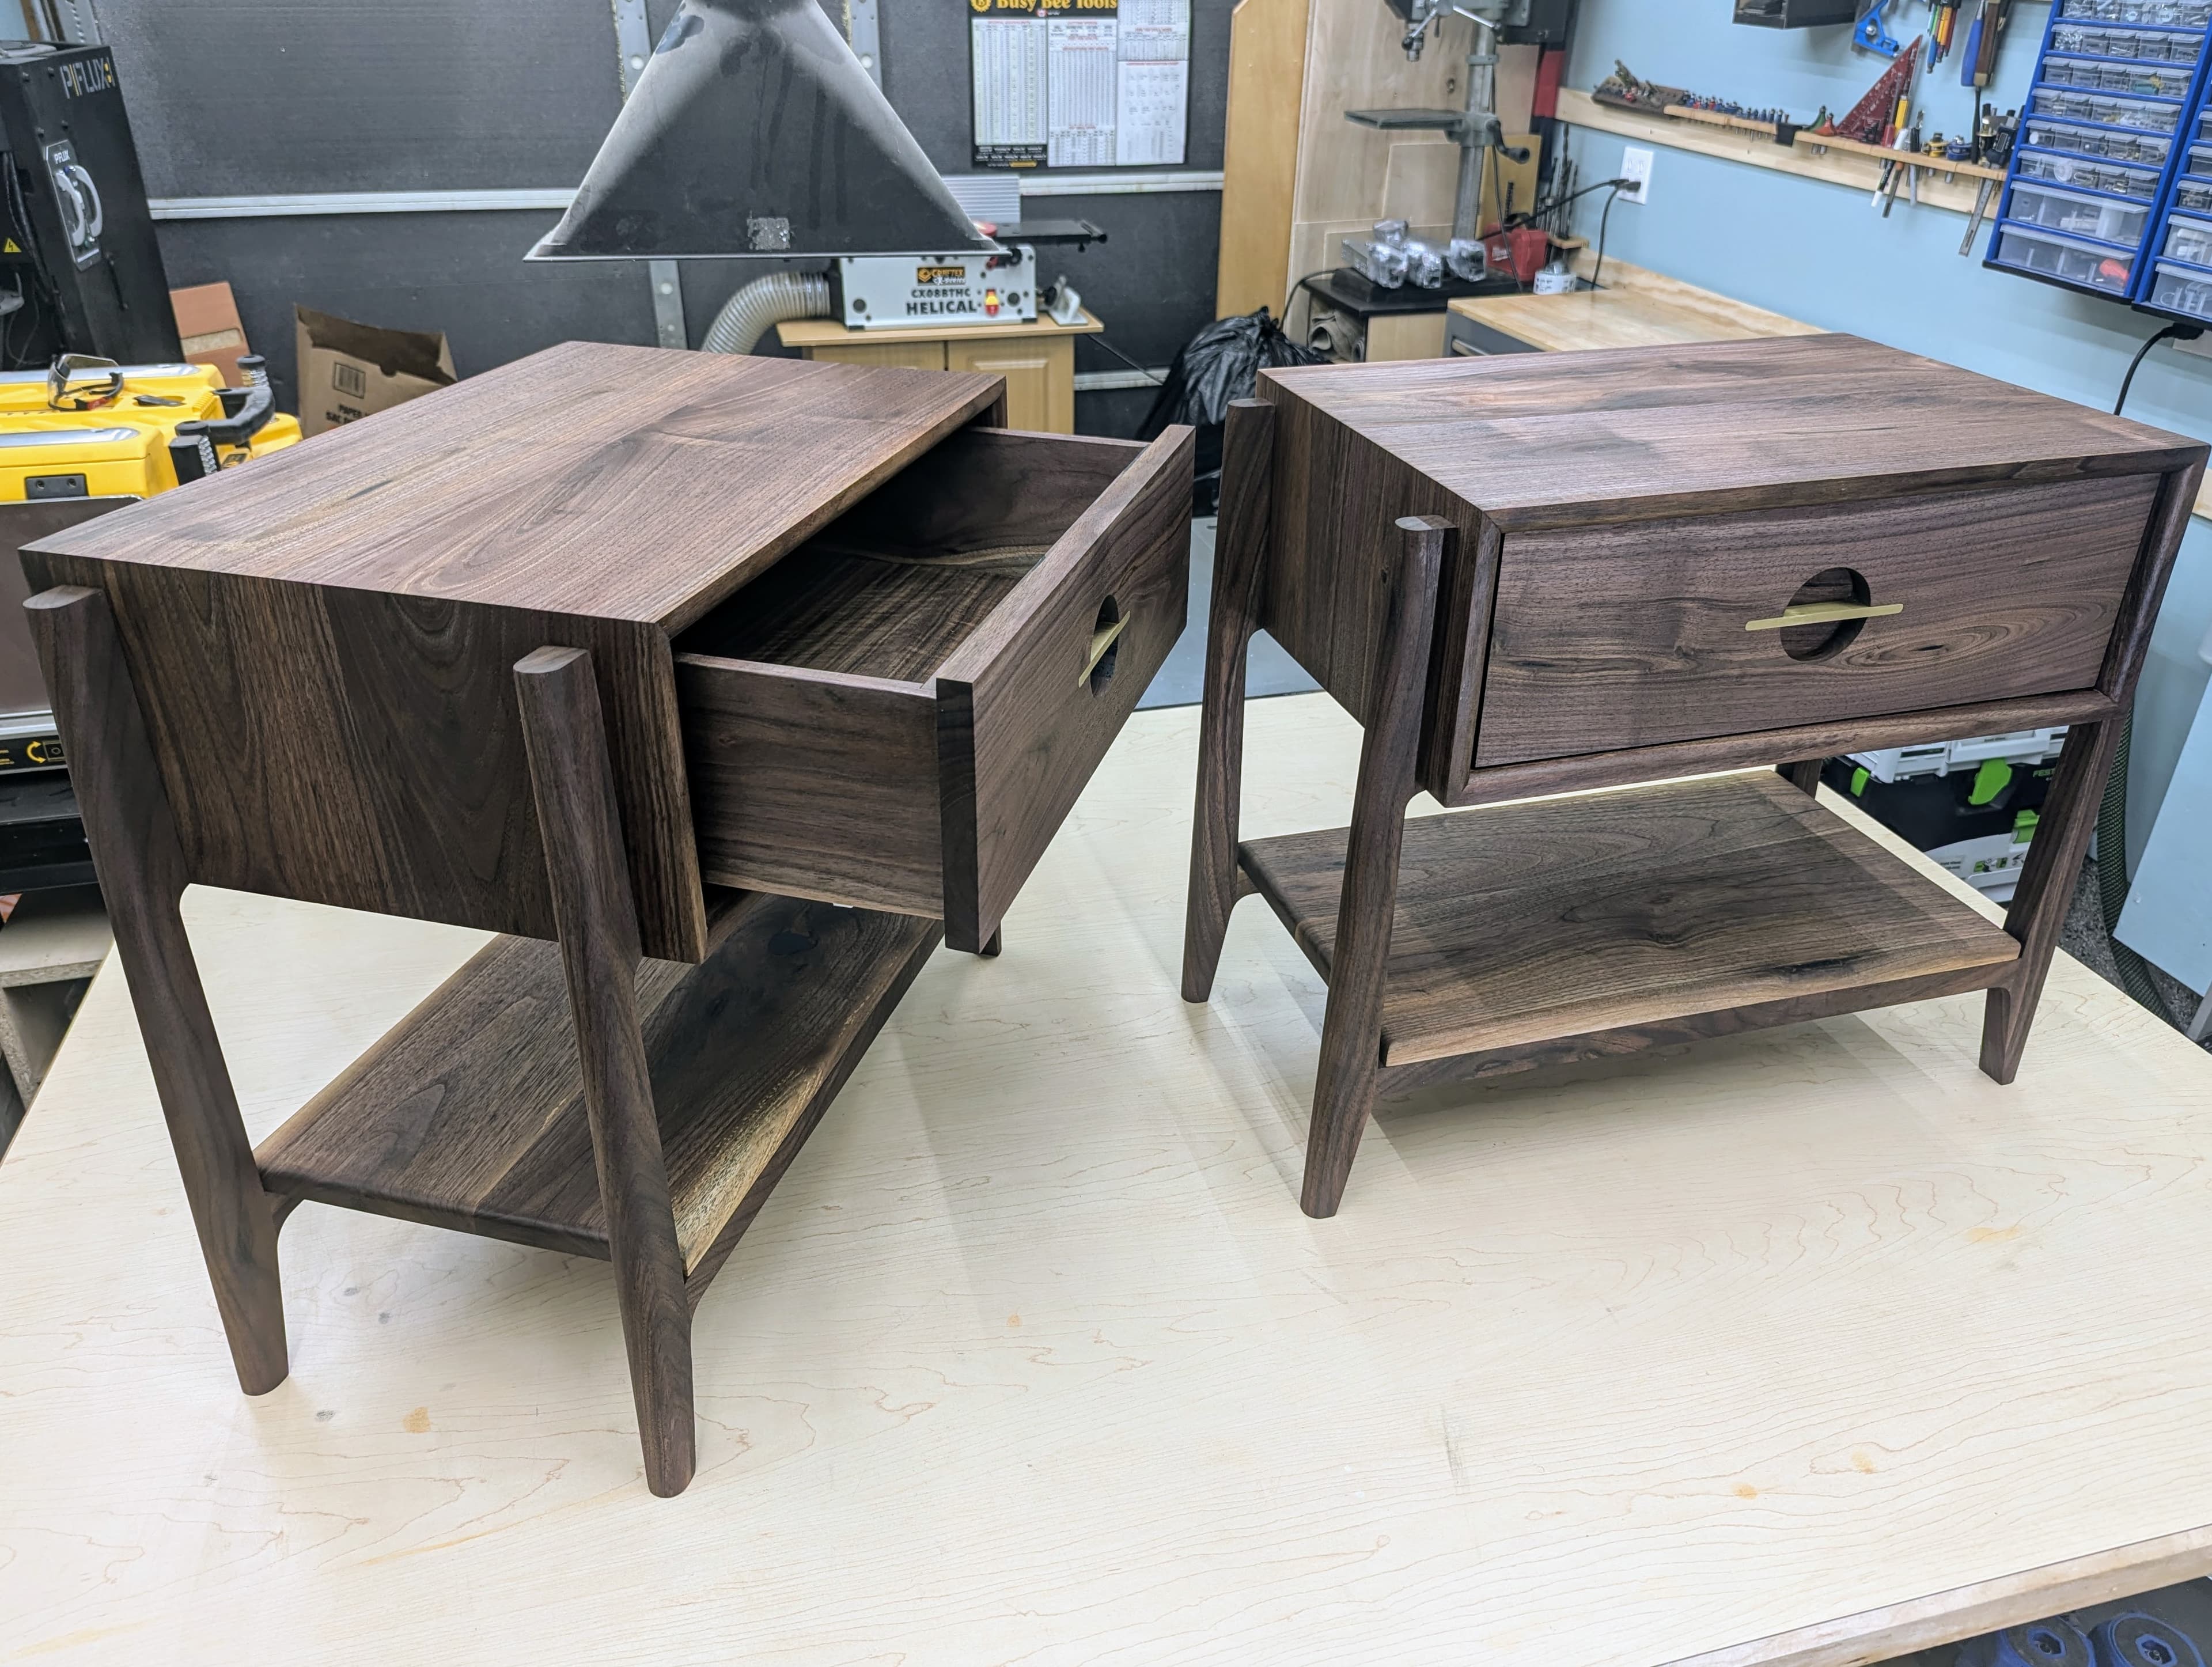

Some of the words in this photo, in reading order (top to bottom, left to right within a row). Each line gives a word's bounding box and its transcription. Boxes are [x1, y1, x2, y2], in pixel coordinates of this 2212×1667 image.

[997, 0, 1036, 12] Busy
[1041, 0, 1071, 9] Bee
[1076, 0, 1118, 9] Tools
[906, 301, 977, 315] HELICAL
